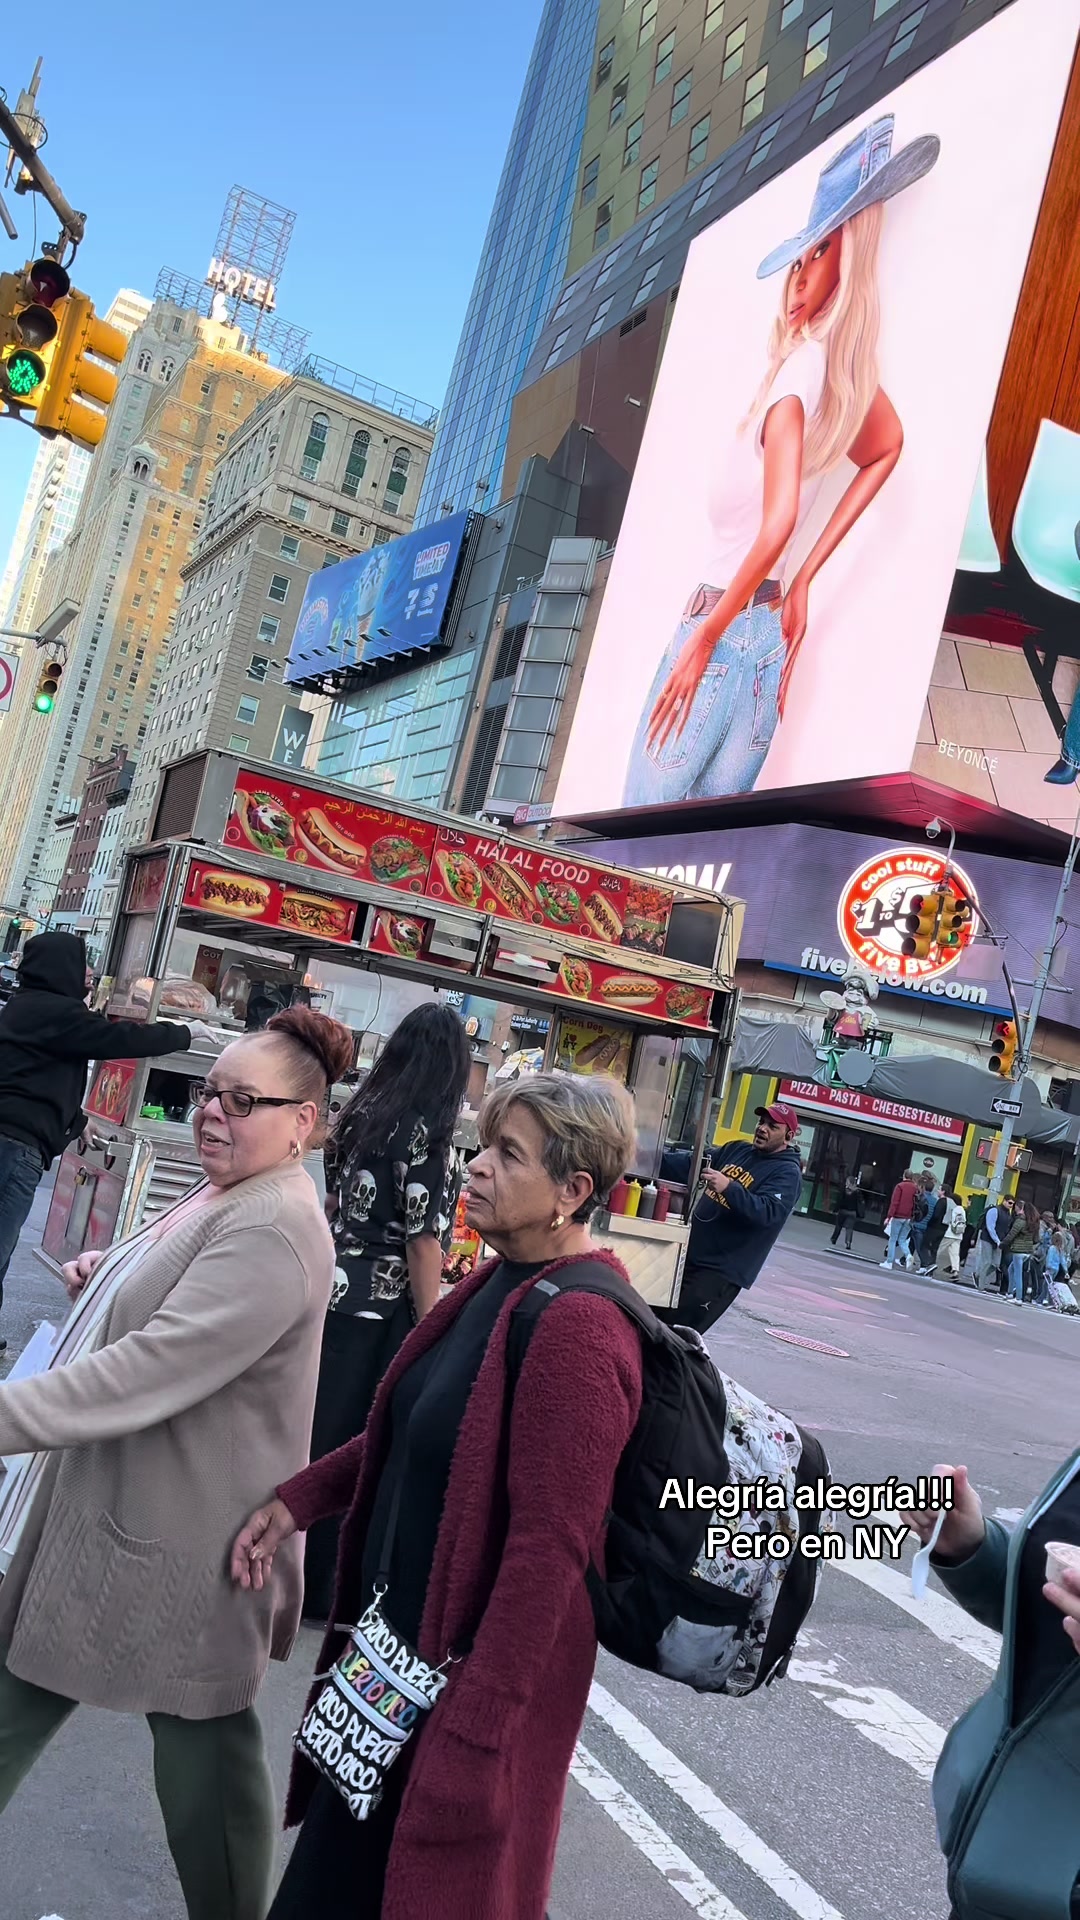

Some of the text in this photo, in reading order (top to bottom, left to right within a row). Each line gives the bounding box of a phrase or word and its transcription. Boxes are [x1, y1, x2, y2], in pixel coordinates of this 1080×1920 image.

[207, 257, 277, 309] HOTEL
[416, 543, 449, 565] LIMITED
[938, 738, 999, 775] BEYONCÉ
[528, 803, 552, 818] OUTDOO
[439, 829, 467, 845] حلال
[473, 839, 591, 885] HALAL FOOD
[861, 857, 941, 891] cool stuff
[879, 911, 893, 921] TO
[858, 941, 900, 972] five
[562, 1016, 604, 1034] Corn Dog
[789, 1080, 953, 1129] PIZZA PASTA CHEESESTEAKS
[363, 1618, 398, 1659] RICO
[317, 1686, 348, 1728] RICO
[375, 1689, 419, 1728] RICO
[301, 1711, 377, 1791] UERTO RICO
